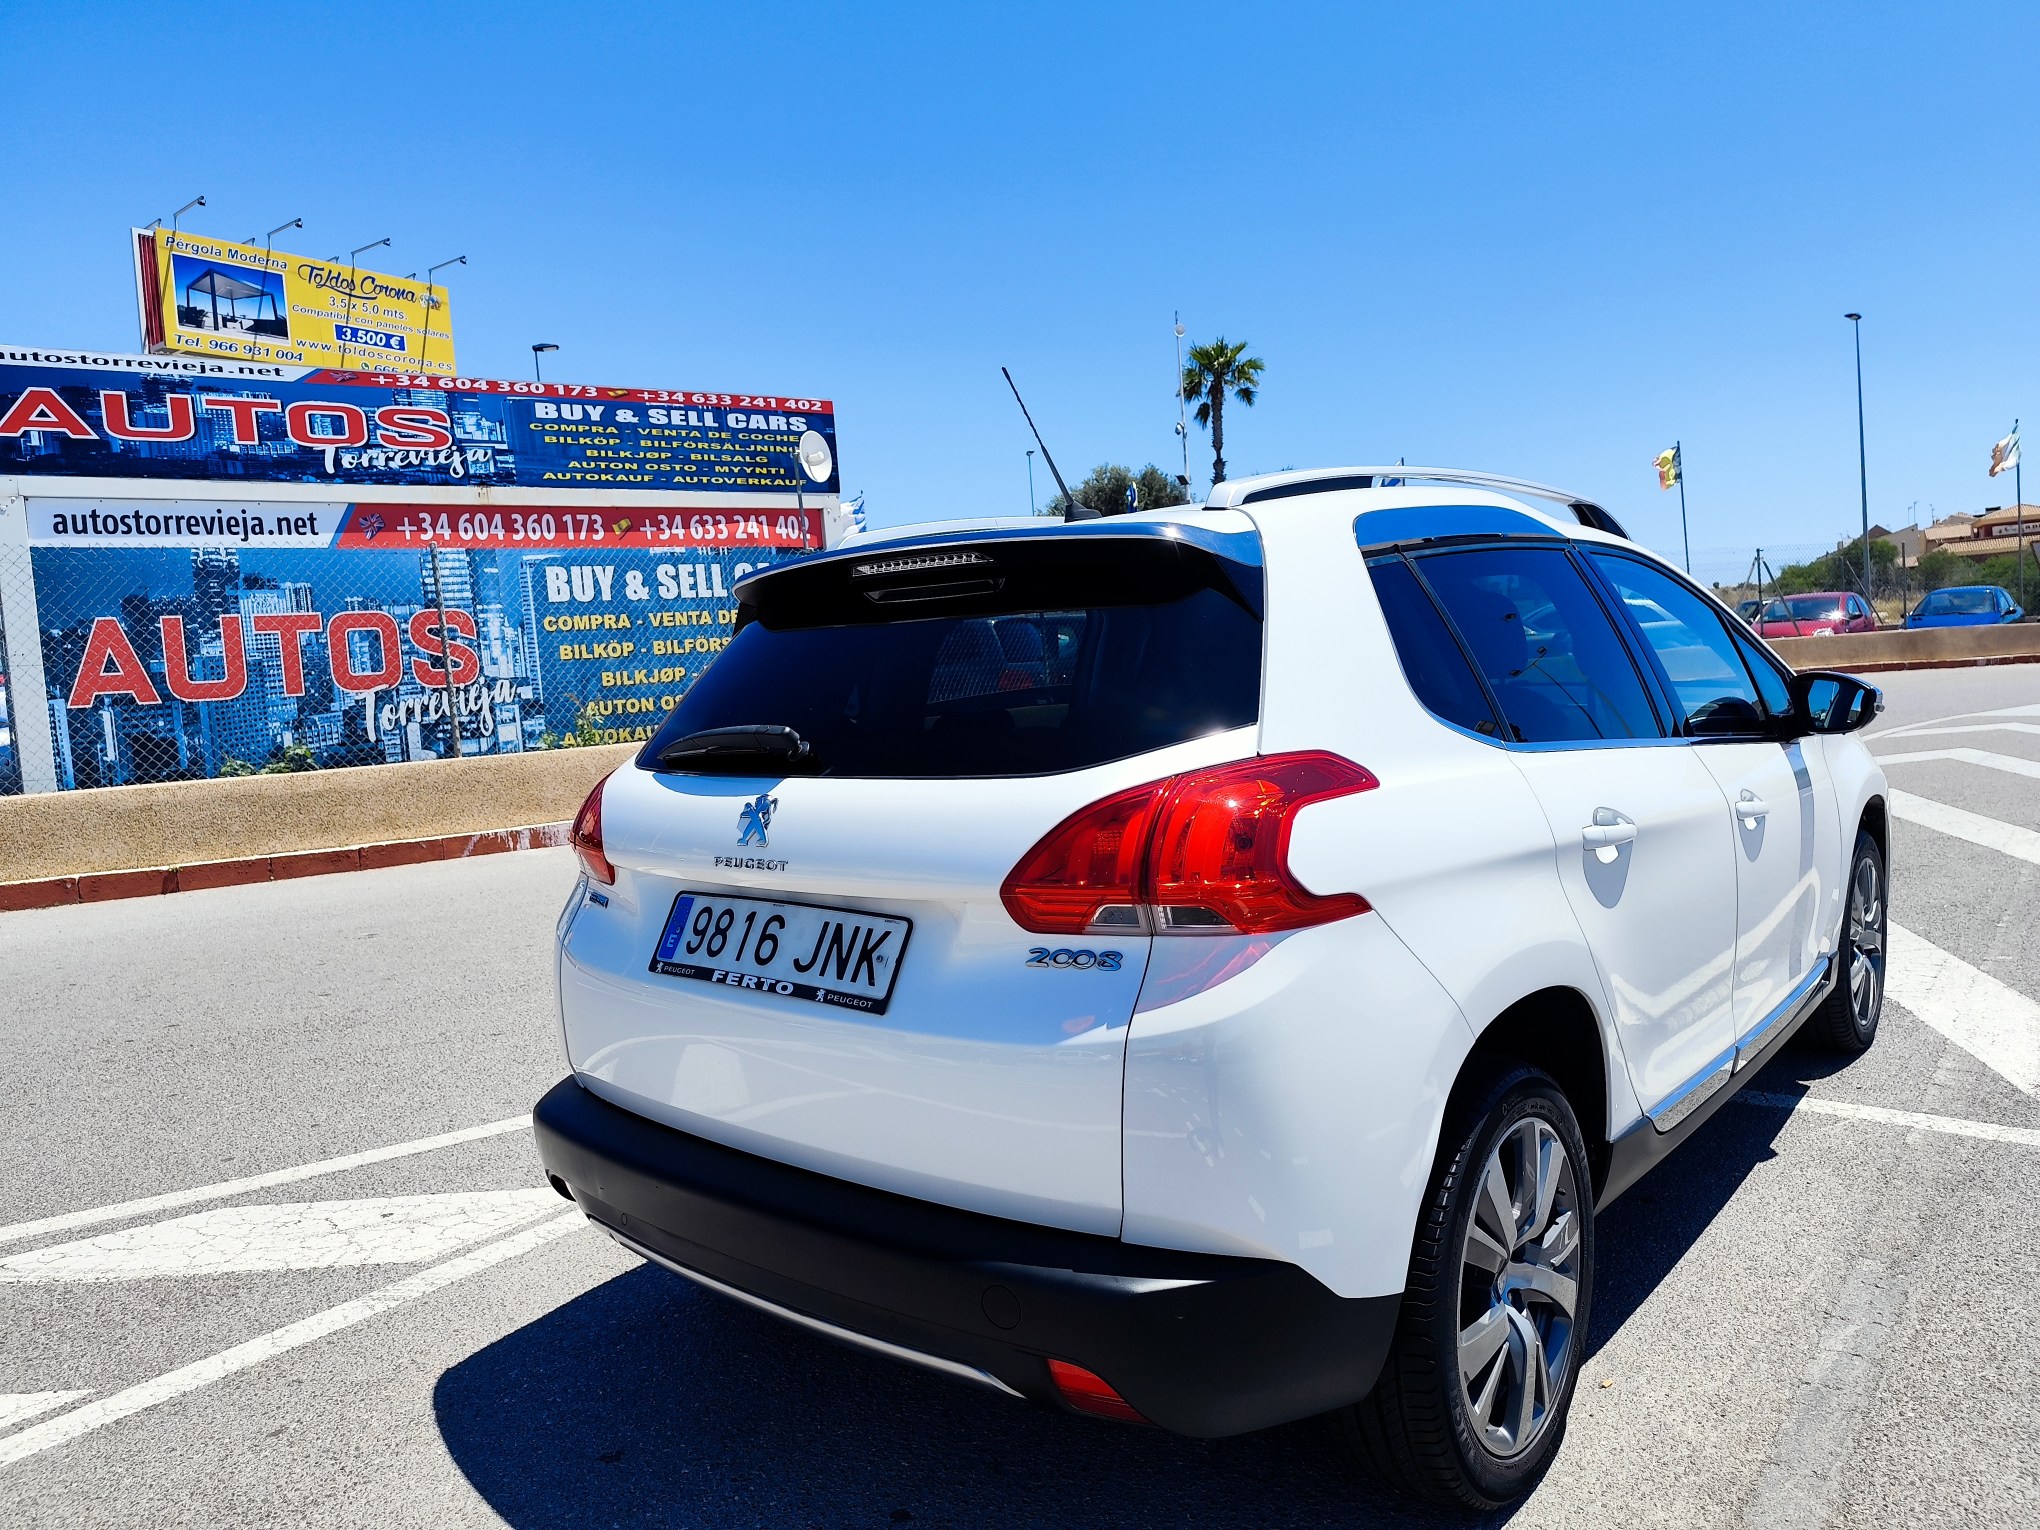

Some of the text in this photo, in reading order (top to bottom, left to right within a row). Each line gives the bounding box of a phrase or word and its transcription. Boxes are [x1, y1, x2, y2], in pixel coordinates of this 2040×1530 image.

[165, 236, 288, 270] Pérgola Moderna
[297, 264, 417, 303] Toldos Corona
[329, 296, 408, 321] 3,5 x 5,0 mts.
[292, 304, 450, 340] Compatible con paneles solares
[174, 334, 304, 363] Tel. 966 931 004
[341, 327, 401, 349] 3.500 €
[295, 338, 453, 371] www.toldoscorona.es
[371, 374, 598, 397] +34 604 360 173
[637, 391, 823, 411] +34 633 241 402
[0, 386, 454, 452] AUTOS
[534, 402, 808, 432] BUY & SELL CARS
[529, 423, 619, 434] COMPRA
[637, 427, 702, 438] VENTA
[708, 431, 732, 440] DE
[738, 433, 801, 442] COCHE
[544, 436, 621, 446] BILKÖP
[313, 444, 491, 478] Torrevieja
[568, 460, 638, 470] AUTON
[645, 463, 697, 472] OSTO
[714, 465, 785, 475] MYYNTI
[586, 449, 672, 459] BILKJØP
[690, 453, 768, 463] BILSALG
[543, 472, 654, 482] AUTOKAUF
[673, 476, 807, 486] AUTOVERKAUF
[52, 508, 320, 543] autostorrevieja.net
[397, 512, 605, 541] +34 604 360 173
[639, 514, 811, 541] +34 633 241 402
[545, 564, 615, 603] BUY
[625, 569, 650, 602] &
[656, 563, 728, 600] SELL
[543, 613, 631, 632] COMPRA
[649, 610, 712, 627] VENTA
[67, 608, 480, 709] AUTOS
[559, 640, 635, 660] BILKÖP
[602, 666, 686, 687] BILKJØP
[355, 676, 517, 743] Torrevieja
[586, 697, 655, 717] AUTON
[713, 856, 789, 872] PEUGEOT
[666, 906, 893, 987] E 9816 JNK
[1025, 947, 1124, 971] 2008
[663, 965, 696, 976] PEUGEOT
[711, 970, 794, 995] FERTO
[827, 993, 874, 1009] PEUGEOT
